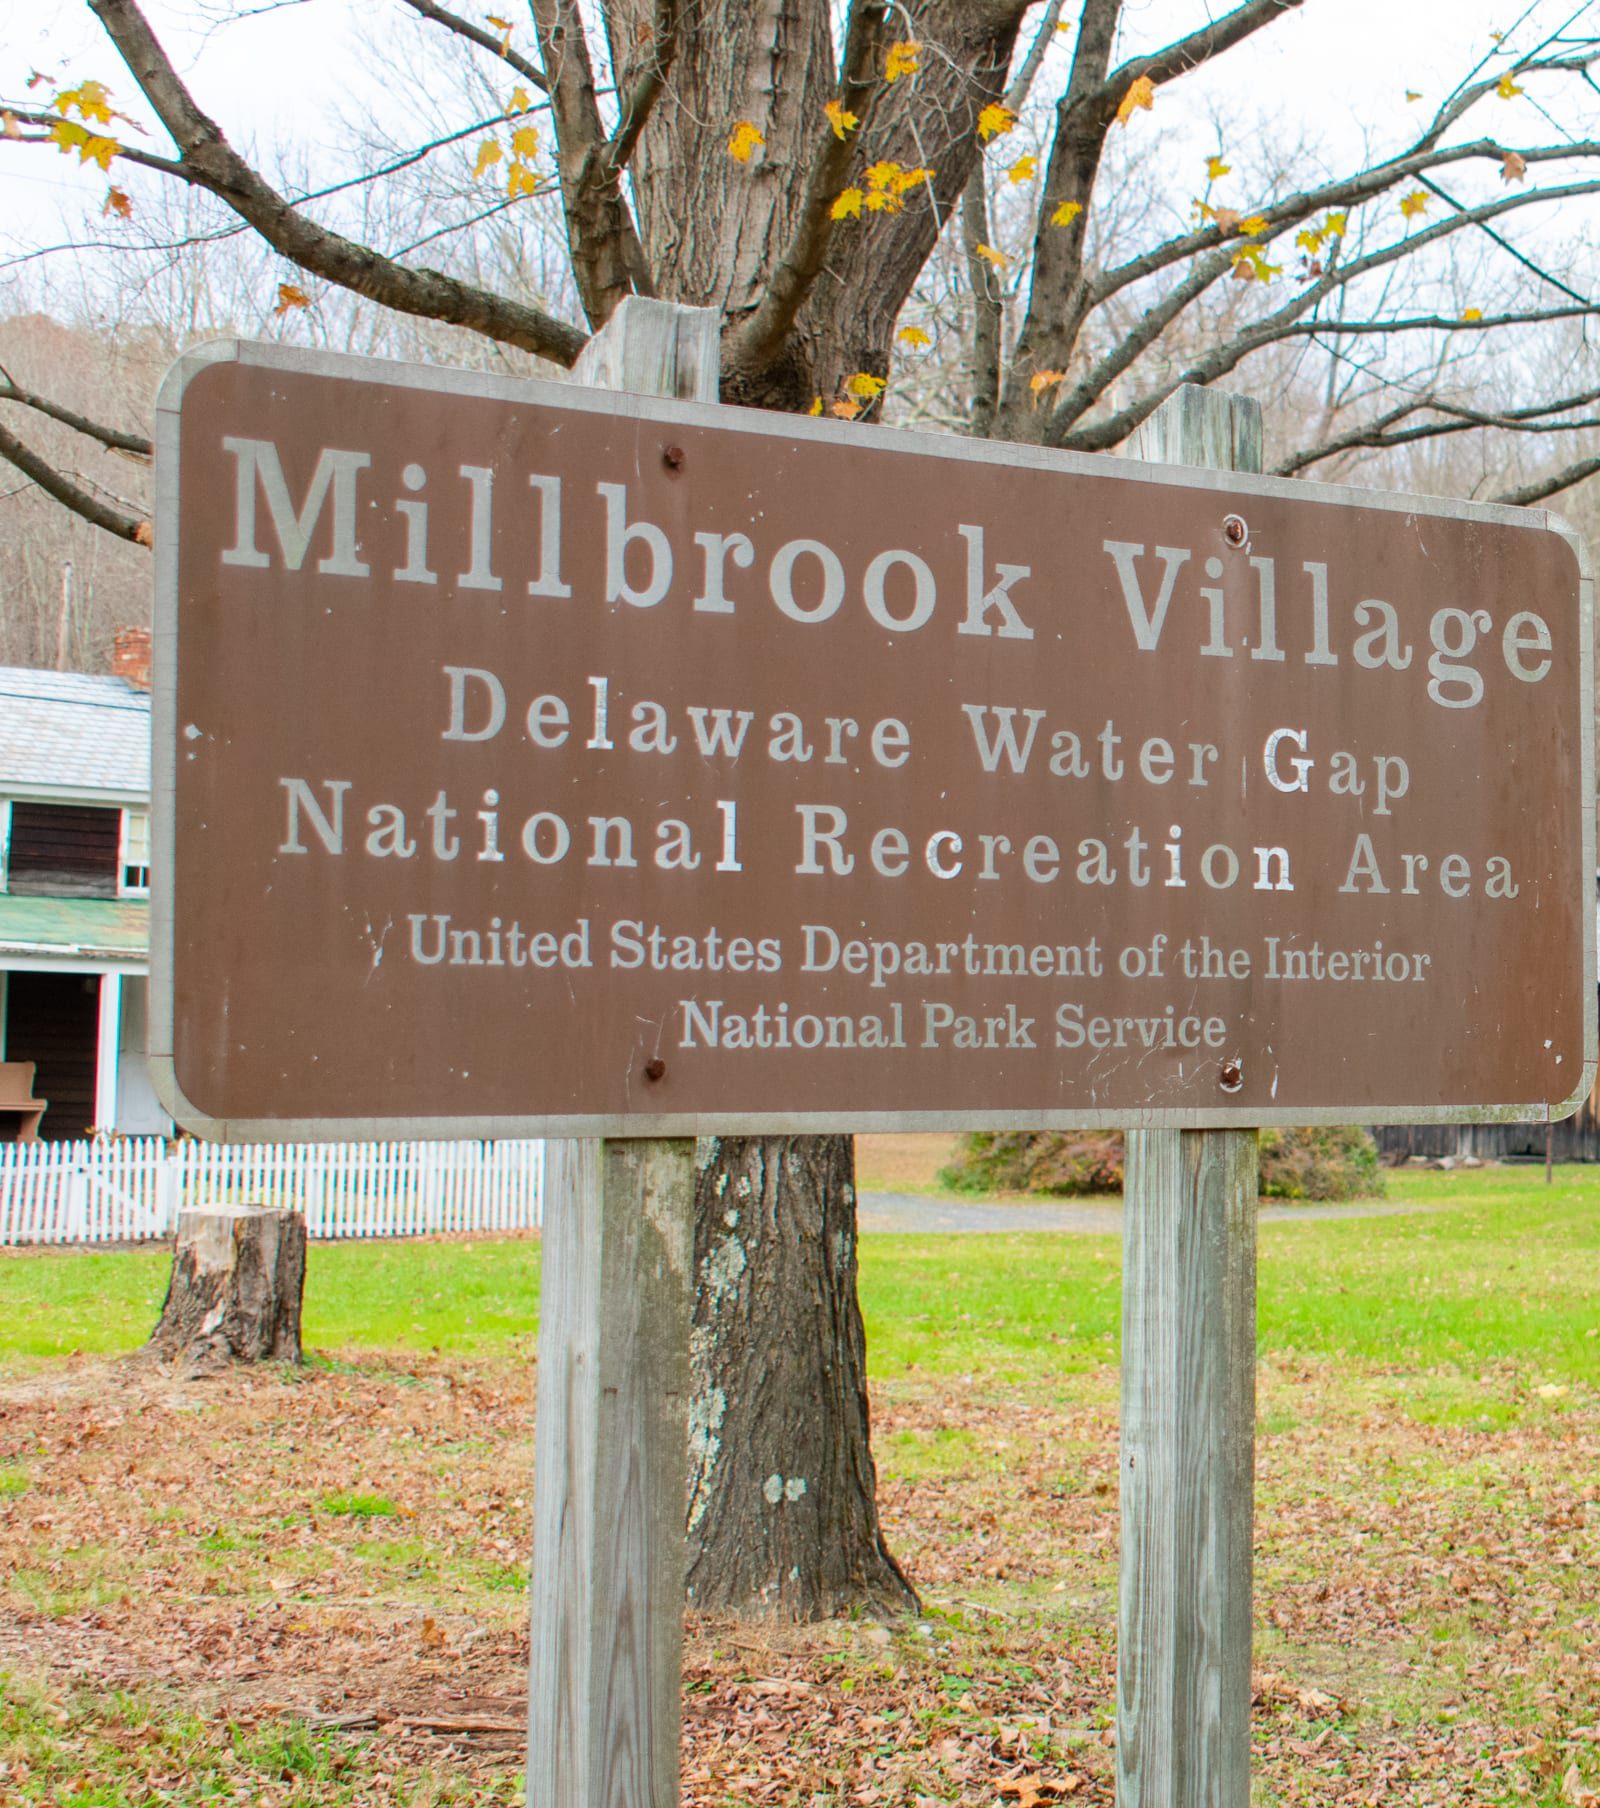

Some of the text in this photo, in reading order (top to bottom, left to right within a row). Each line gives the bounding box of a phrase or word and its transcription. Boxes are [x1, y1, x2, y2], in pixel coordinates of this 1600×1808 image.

[222, 436, 1553, 708] Millbrook Village
[442, 666, 1410, 815] Delaware Water Gap
[278, 778, 1519, 899] National Recreation Area
[409, 915, 1432, 987] United States Department of the Interior
[680, 1000, 1227, 1049] National Park Service
